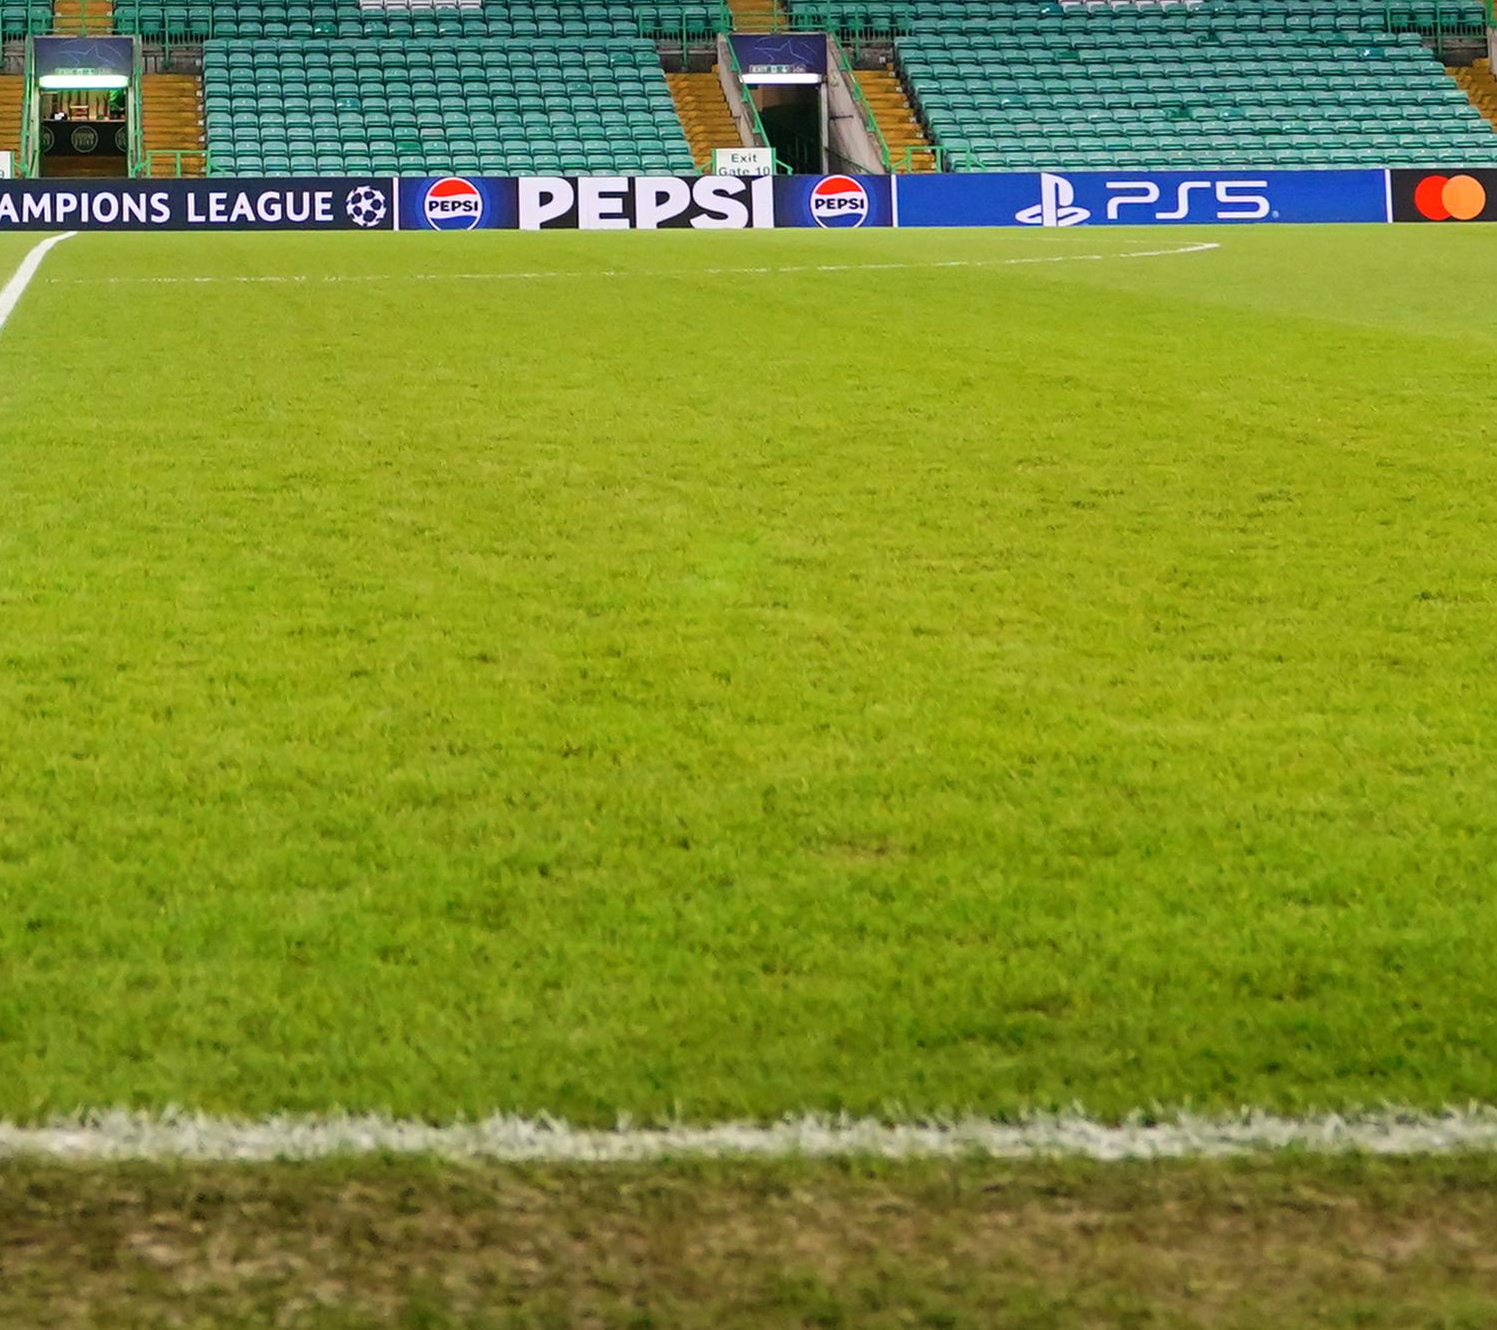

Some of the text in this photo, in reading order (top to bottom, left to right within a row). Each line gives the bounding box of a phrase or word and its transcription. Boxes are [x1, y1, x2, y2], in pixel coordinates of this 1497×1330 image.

[730, 154, 757, 163] Exit
[718, 167, 771, 177] Gate 10
[187, 190, 334, 223] LEAGUE
[428, 200, 479, 213] PEPSI
[519, 175, 775, 230] PEPSI
[814, 197, 865, 211] PEPSI
[1106, 180, 1271, 221] PS5
